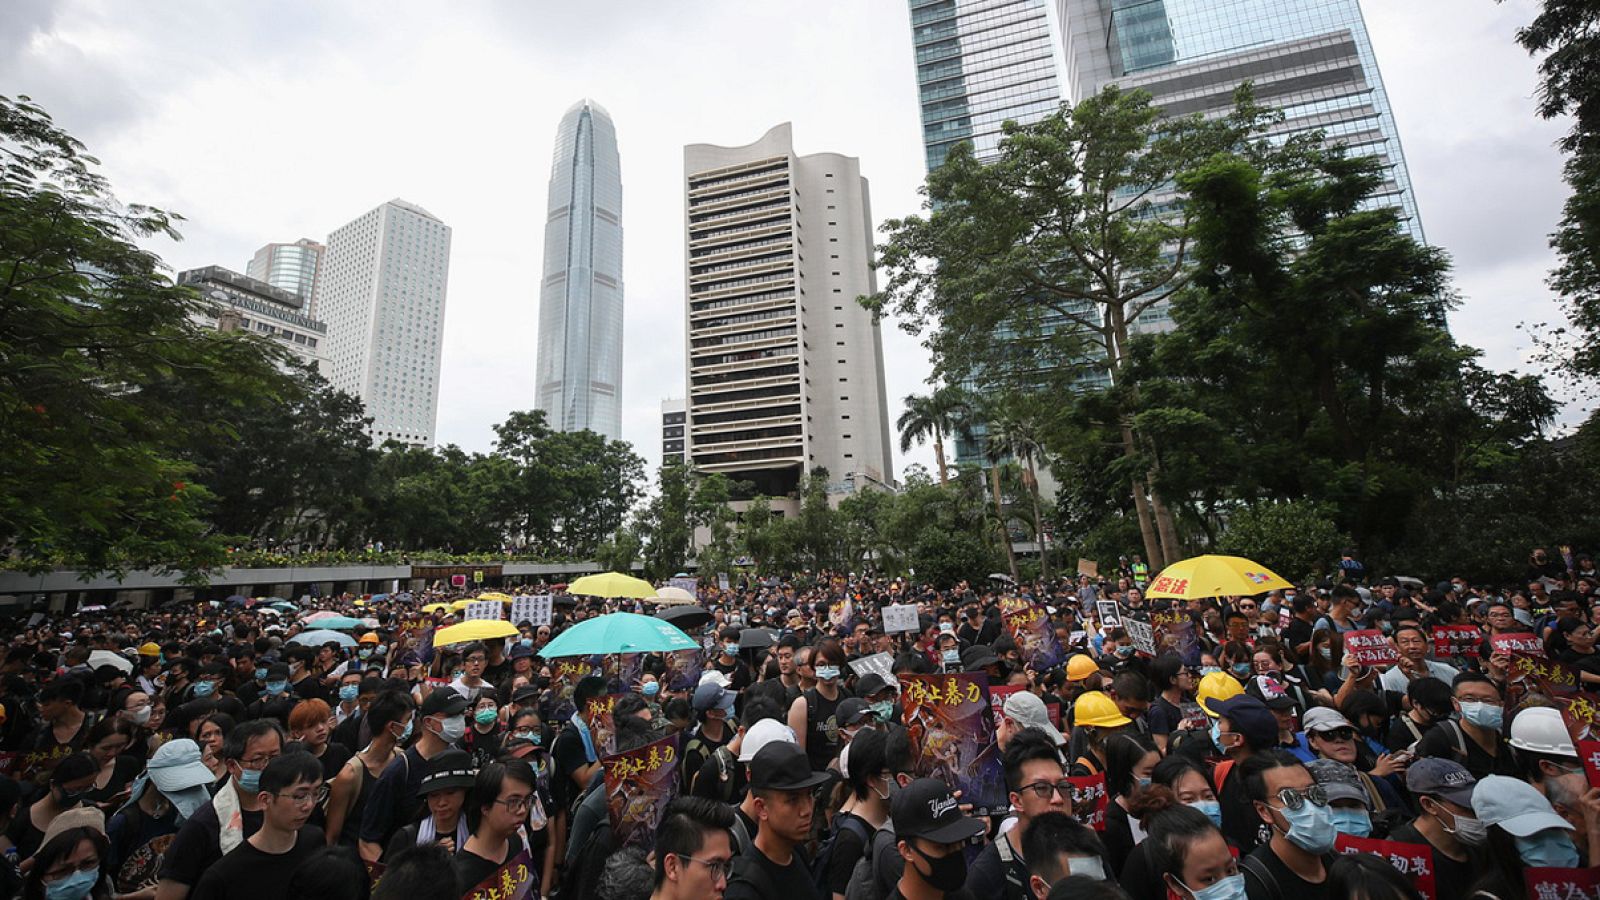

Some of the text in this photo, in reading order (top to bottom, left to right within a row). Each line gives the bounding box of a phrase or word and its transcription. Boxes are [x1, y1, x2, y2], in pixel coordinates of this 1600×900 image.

[906, 677, 980, 706] 停止暴力
[610, 745, 675, 780] 停止暴力
